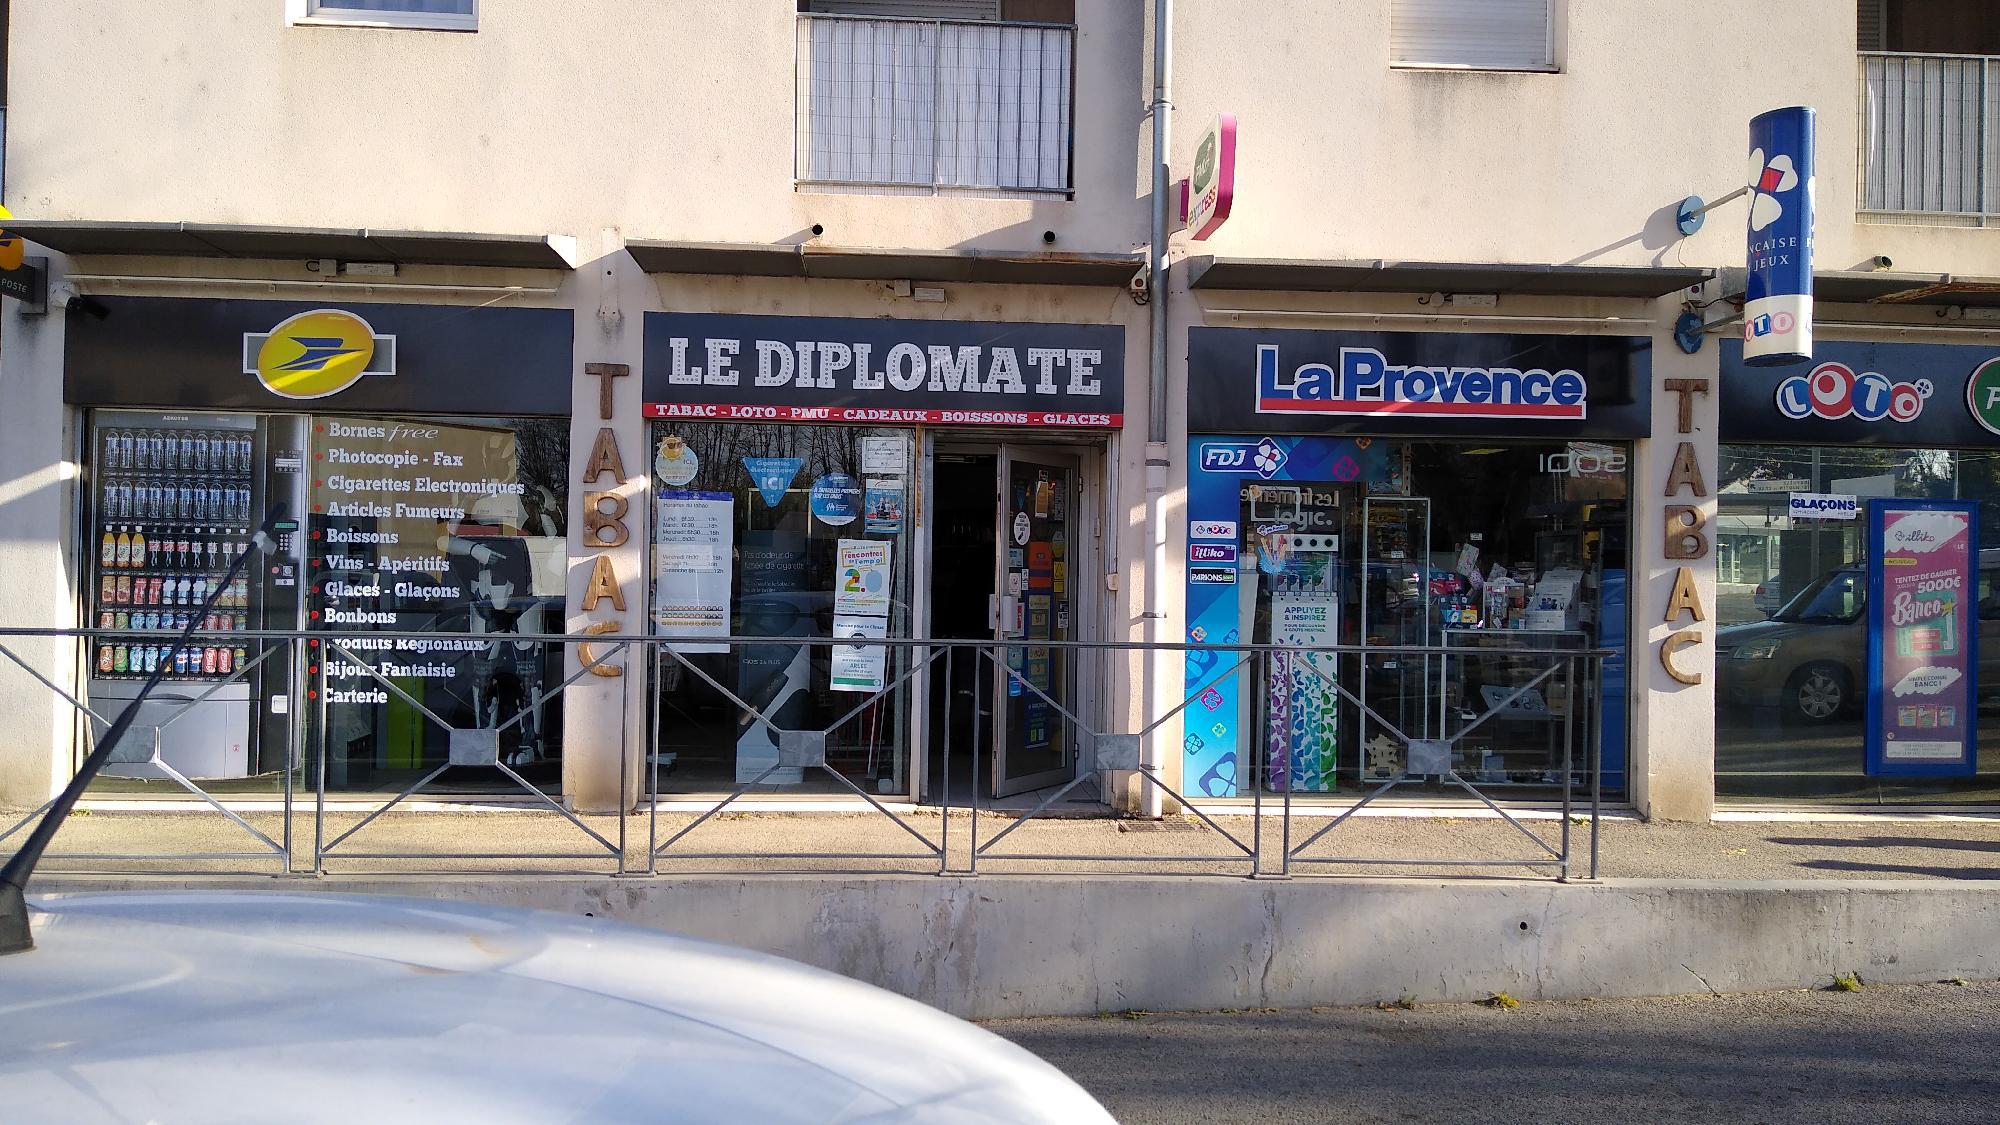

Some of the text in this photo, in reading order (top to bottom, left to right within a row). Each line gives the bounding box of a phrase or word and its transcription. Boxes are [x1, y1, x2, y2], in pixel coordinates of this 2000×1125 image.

[1753, 255, 1789, 272] JEUX
[1, 278, 28, 293] POSTE
[668, 337, 1101, 396] LE DIPLOMATE
[1780, 364, 1922, 421] LOTO
[655, 404, 1110, 425] TABAC LOTO PMU CADEAUX BOISSONS GLACES
[329, 422, 440, 442] Bornes free
[328, 449, 463, 467] Photocopie Fax
[1205, 448, 1247, 467] FDJ
[327, 476, 525, 497] Cigarettes Electroniques
[761, 476, 784, 490] ICI
[327, 502, 465, 519] Articles Fumeurs
[1791, 499, 1856, 512] GLAÇONS
[578, 363, 630, 677] TABAC
[326, 529, 399, 544] Boissons
[1660, 378, 1709, 685] TABAC
[844, 551, 883, 559] rencontres
[1195, 546, 1225, 559] illiko
[325, 555, 450, 574] Vins Apéritifs
[1191, 573, 1223, 581] PARIONS
[1895, 574, 1919, 584] TENTEZ
[1930, 568, 1957, 579] GAGNER
[324, 581, 460, 601] Glaces Glaçons
[1917, 576, 1962, 594] 5000€
[324, 608, 397, 624] Bonbons
[1284, 606, 1327, 614] APPUYEZ
[1892, 591, 1941, 626] Banco
[326, 662, 456, 679] Bijoux Fantaisie
[324, 688, 388, 704] Carterie
